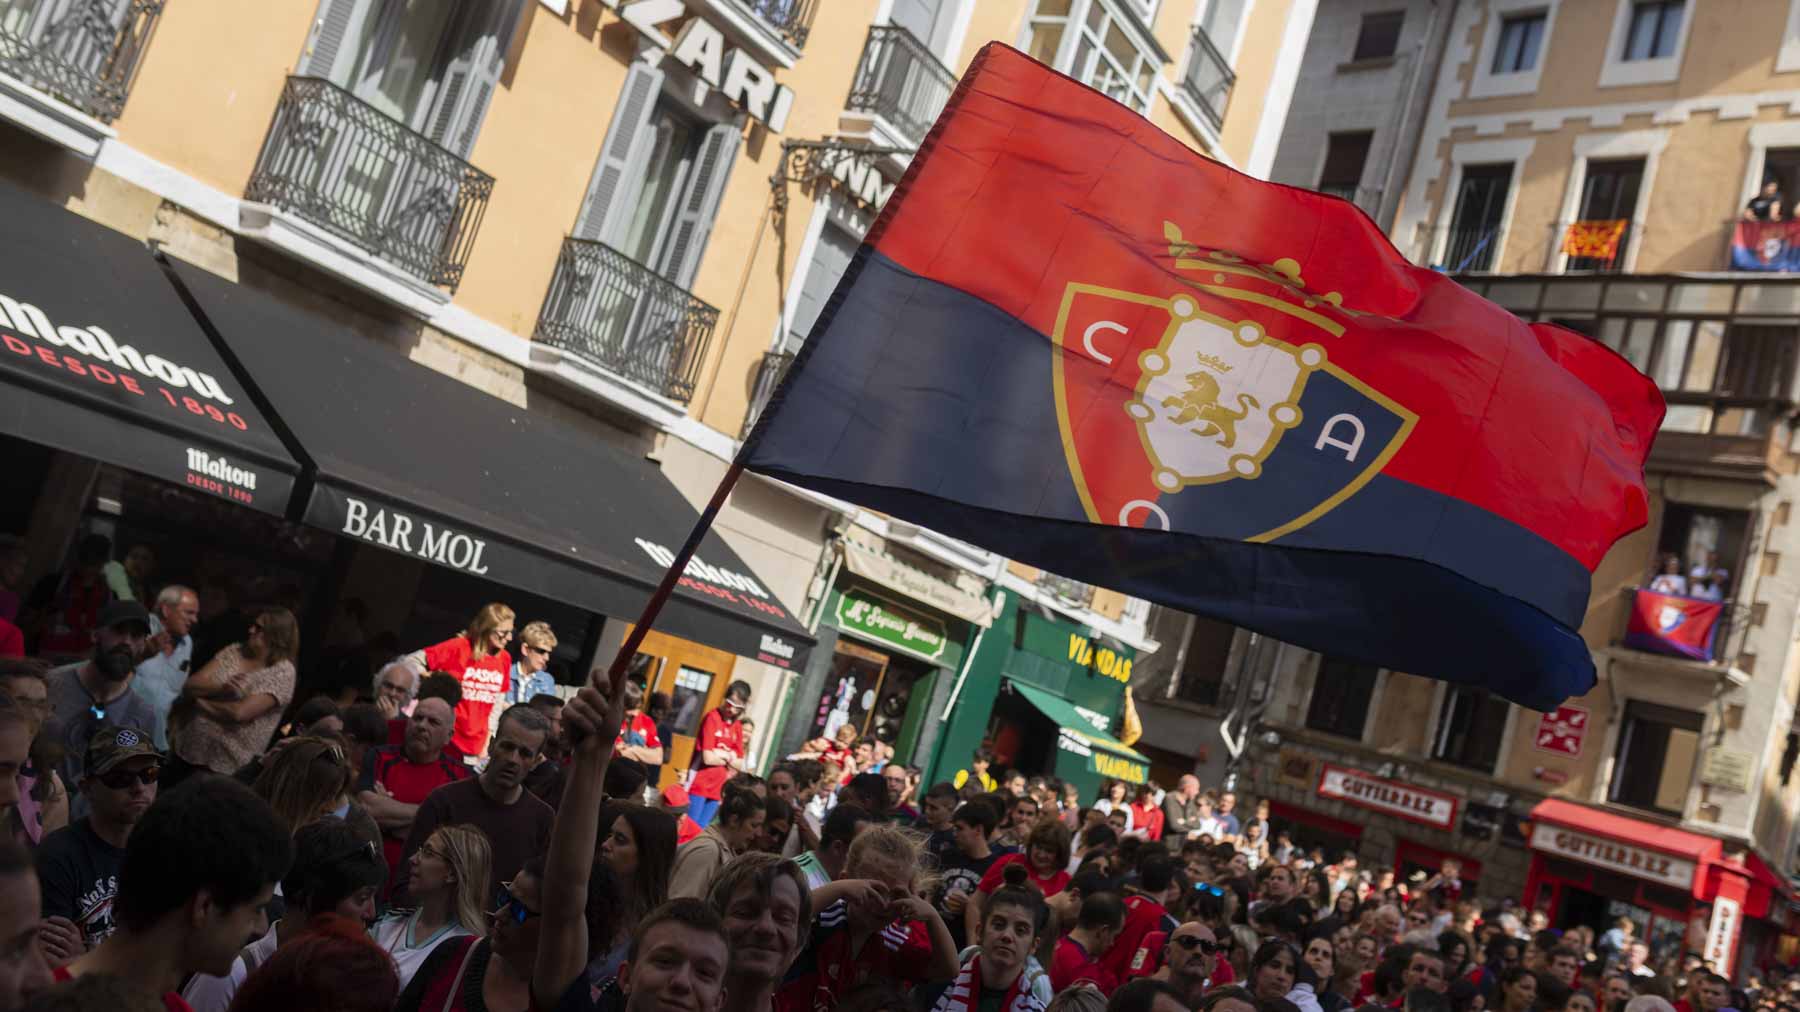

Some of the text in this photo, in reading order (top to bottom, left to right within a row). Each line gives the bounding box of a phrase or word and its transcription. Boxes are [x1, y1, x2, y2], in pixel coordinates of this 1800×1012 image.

[1083, 320, 1129, 364] C
[2, 334, 248, 431] DESDE 1890
[1314, 413, 1366, 462] A
[186, 447, 257, 491] Mahou
[187, 472, 224, 495] DESDE
[343, 498, 489, 575] BAR MOL
[1068, 633, 1133, 683] VIANDAS
[1341, 777, 1435, 815] GUTIERREZ
[1555, 831, 1672, 877] GUTIERREZ
